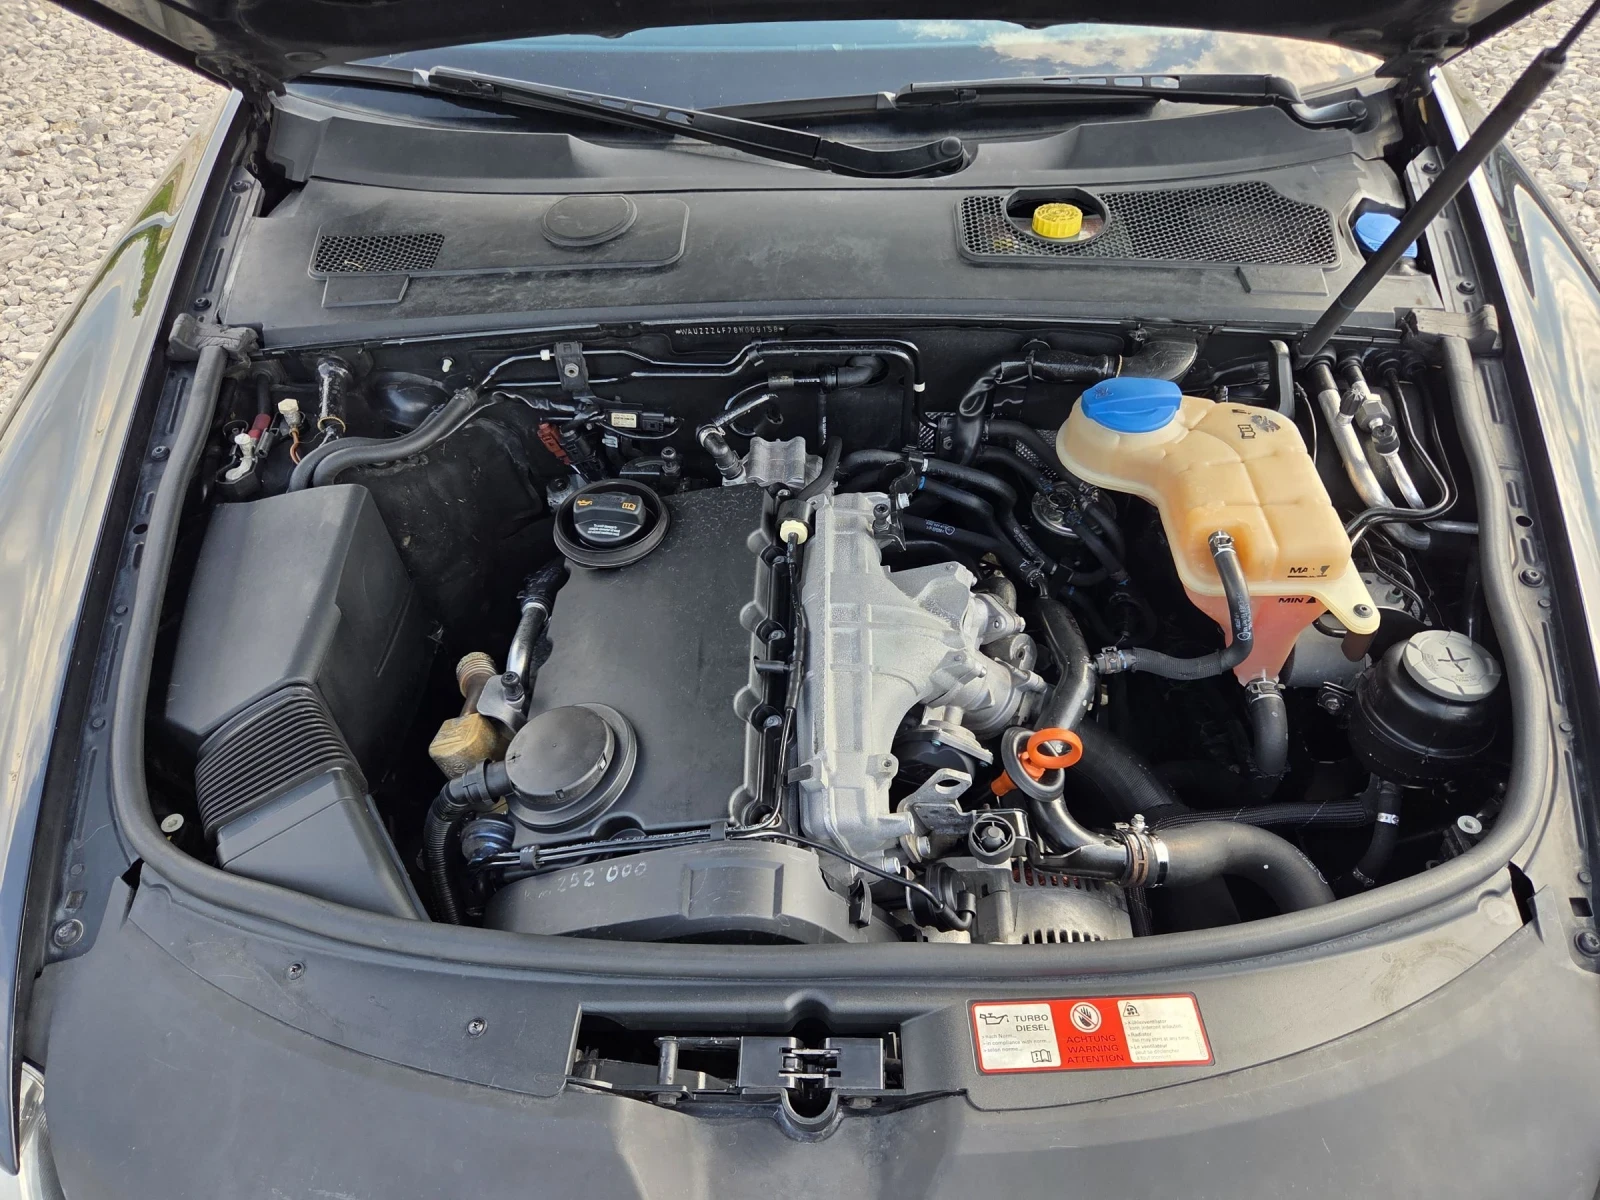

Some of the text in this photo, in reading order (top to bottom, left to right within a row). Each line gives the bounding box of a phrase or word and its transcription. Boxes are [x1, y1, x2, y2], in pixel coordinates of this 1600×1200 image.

[1014, 1014, 1049, 1022] TURBO
[1016, 1024, 1050, 1032] DIESEL
[1066, 1034, 1116, 1044] ACHTUNG
[1067, 1044, 1119, 1053] WARNING
[1067, 1054, 1124, 1064] ATTENTION
